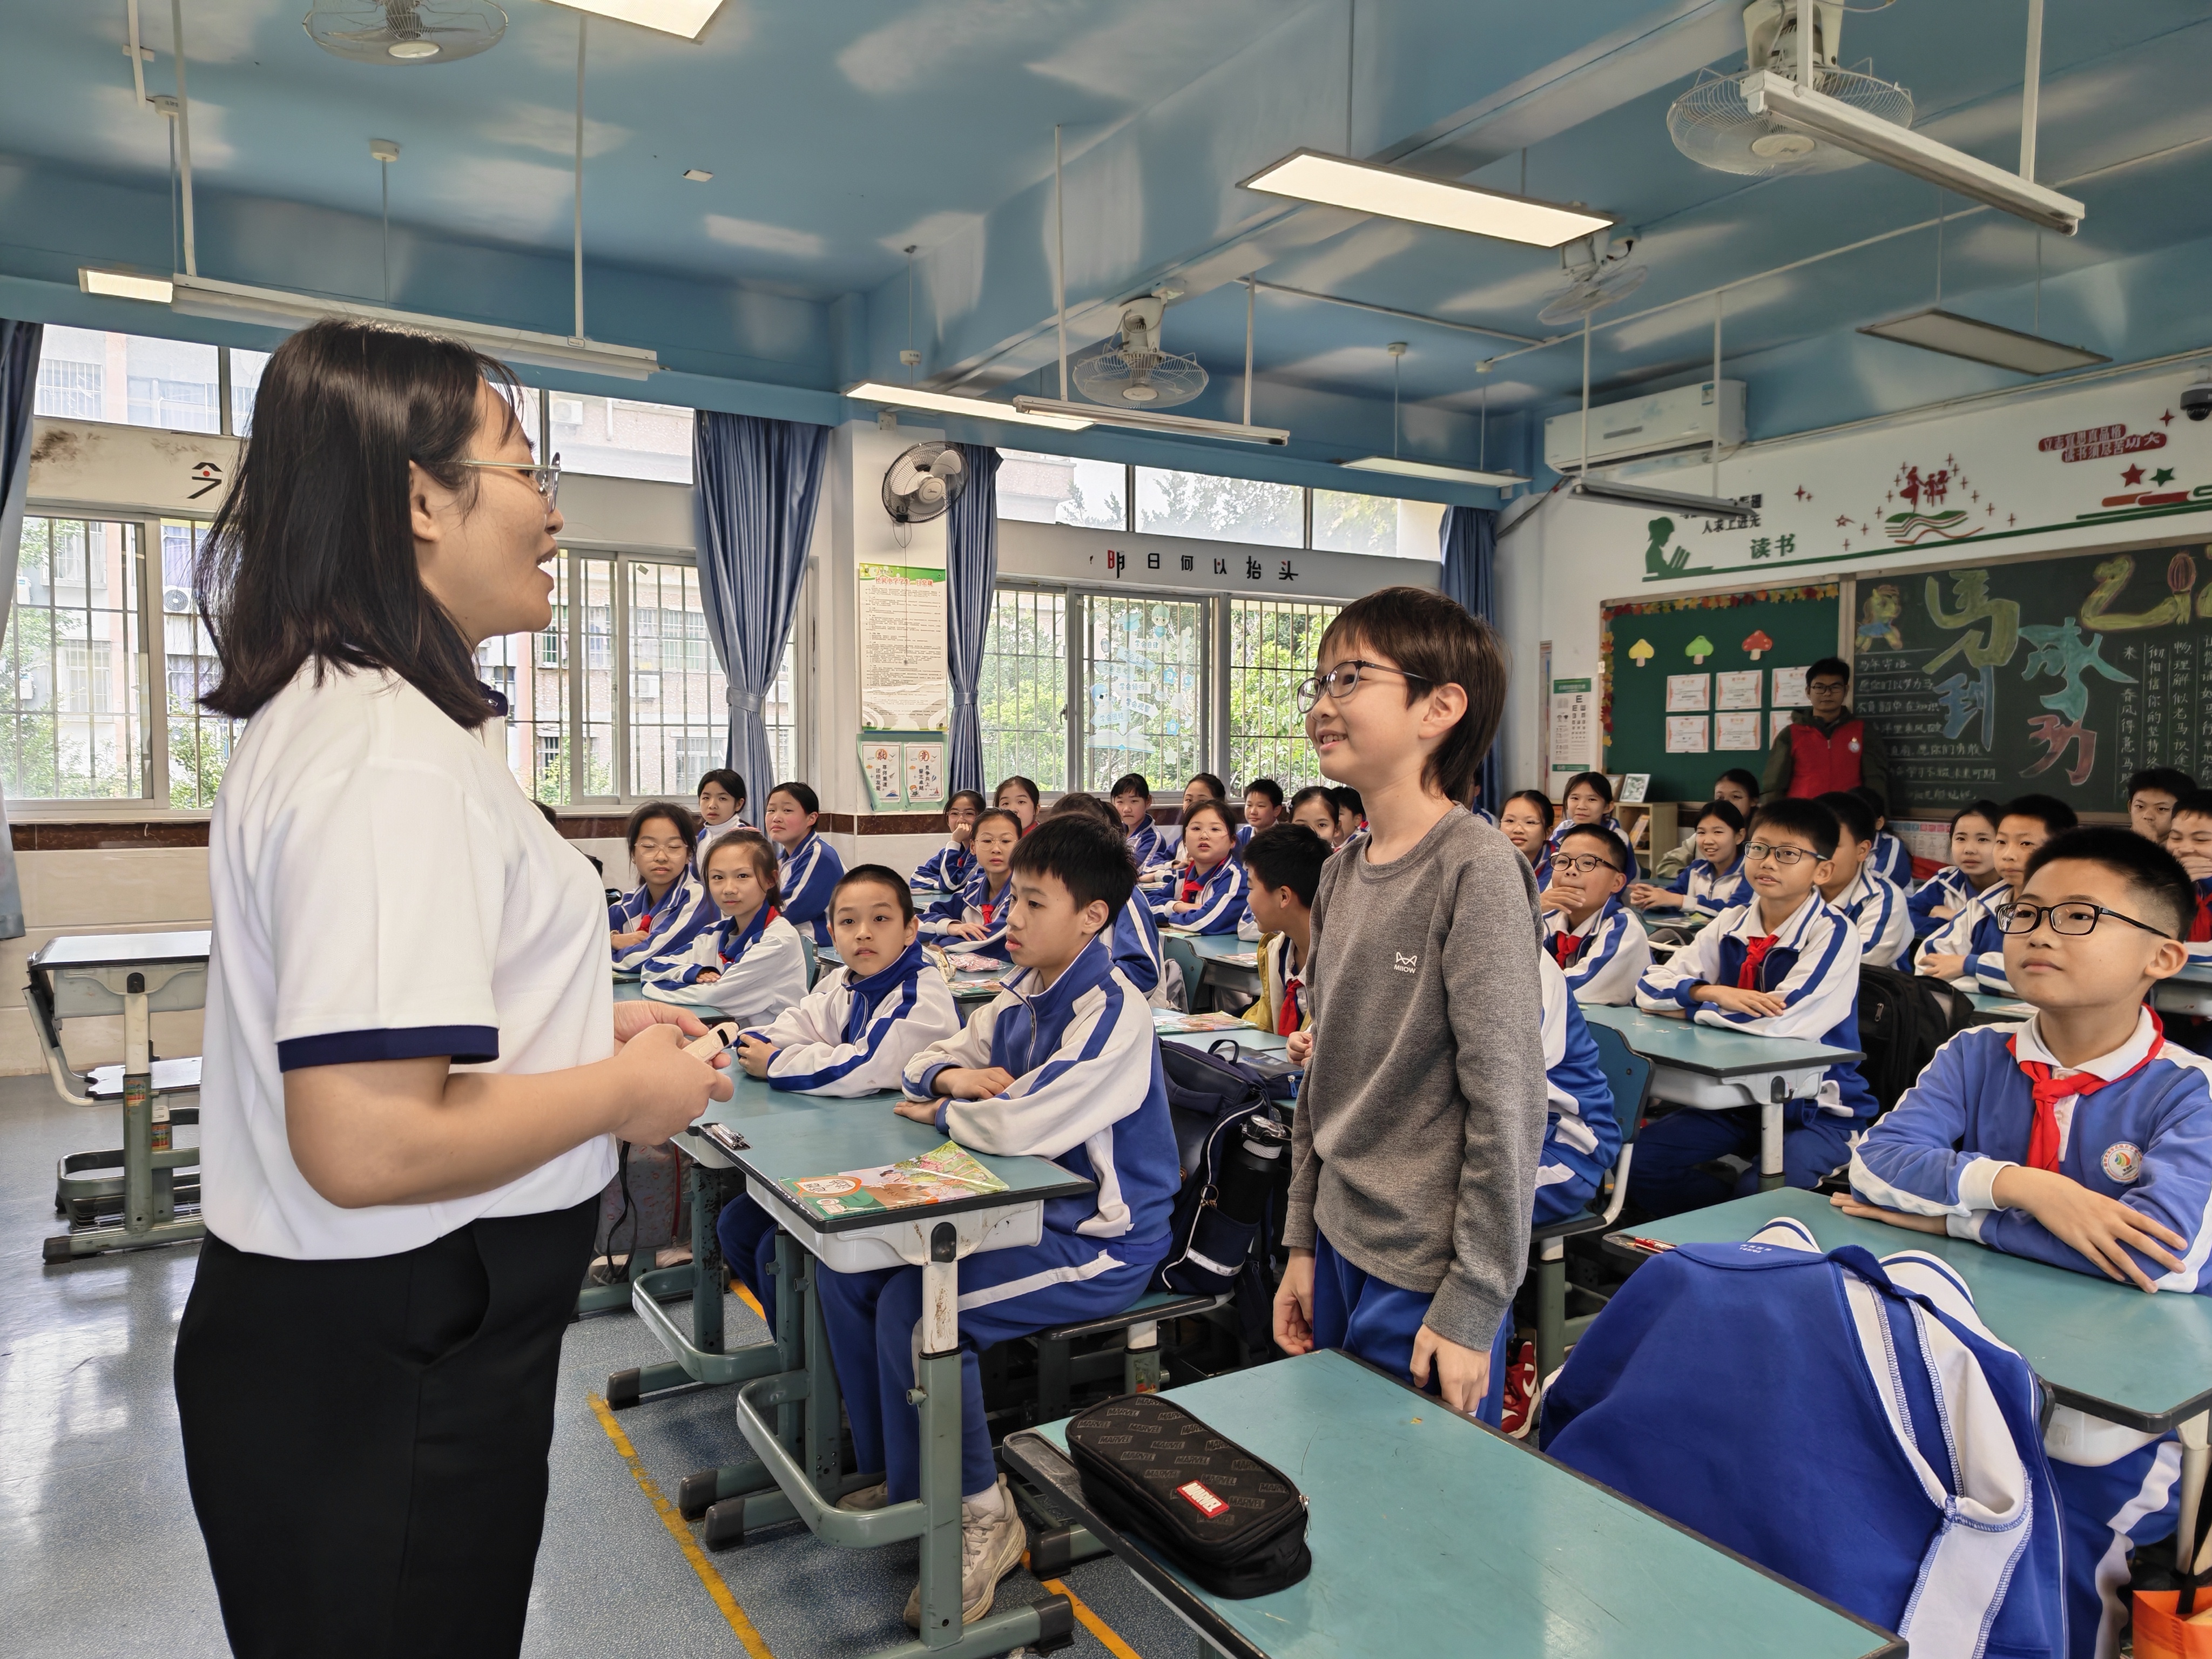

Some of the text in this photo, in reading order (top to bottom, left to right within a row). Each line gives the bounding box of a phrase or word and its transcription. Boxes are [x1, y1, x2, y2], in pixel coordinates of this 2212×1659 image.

[1750, 533, 1796, 559] 读书
[1107, 549, 1299, 582] 明日何以抬头
[877, 751, 887, 761] 敬
[920, 751, 928, 761] 竞
[1394, 964, 1416, 974] MIIOW
[1107, 1408, 1140, 1417] MARVEL
[1077, 1420, 1111, 1428] MARVEL
[1129, 1423, 1162, 1433] MARVEL
[1098, 1435, 1133, 1444] MARVEL
[1151, 1441, 1185, 1449] MARVEL
[1121, 1451, 1156, 1461] MARVEL
[1175, 1456, 1210, 1465] MARVEL
[1182, 1482, 1222, 1513] MARVEL
